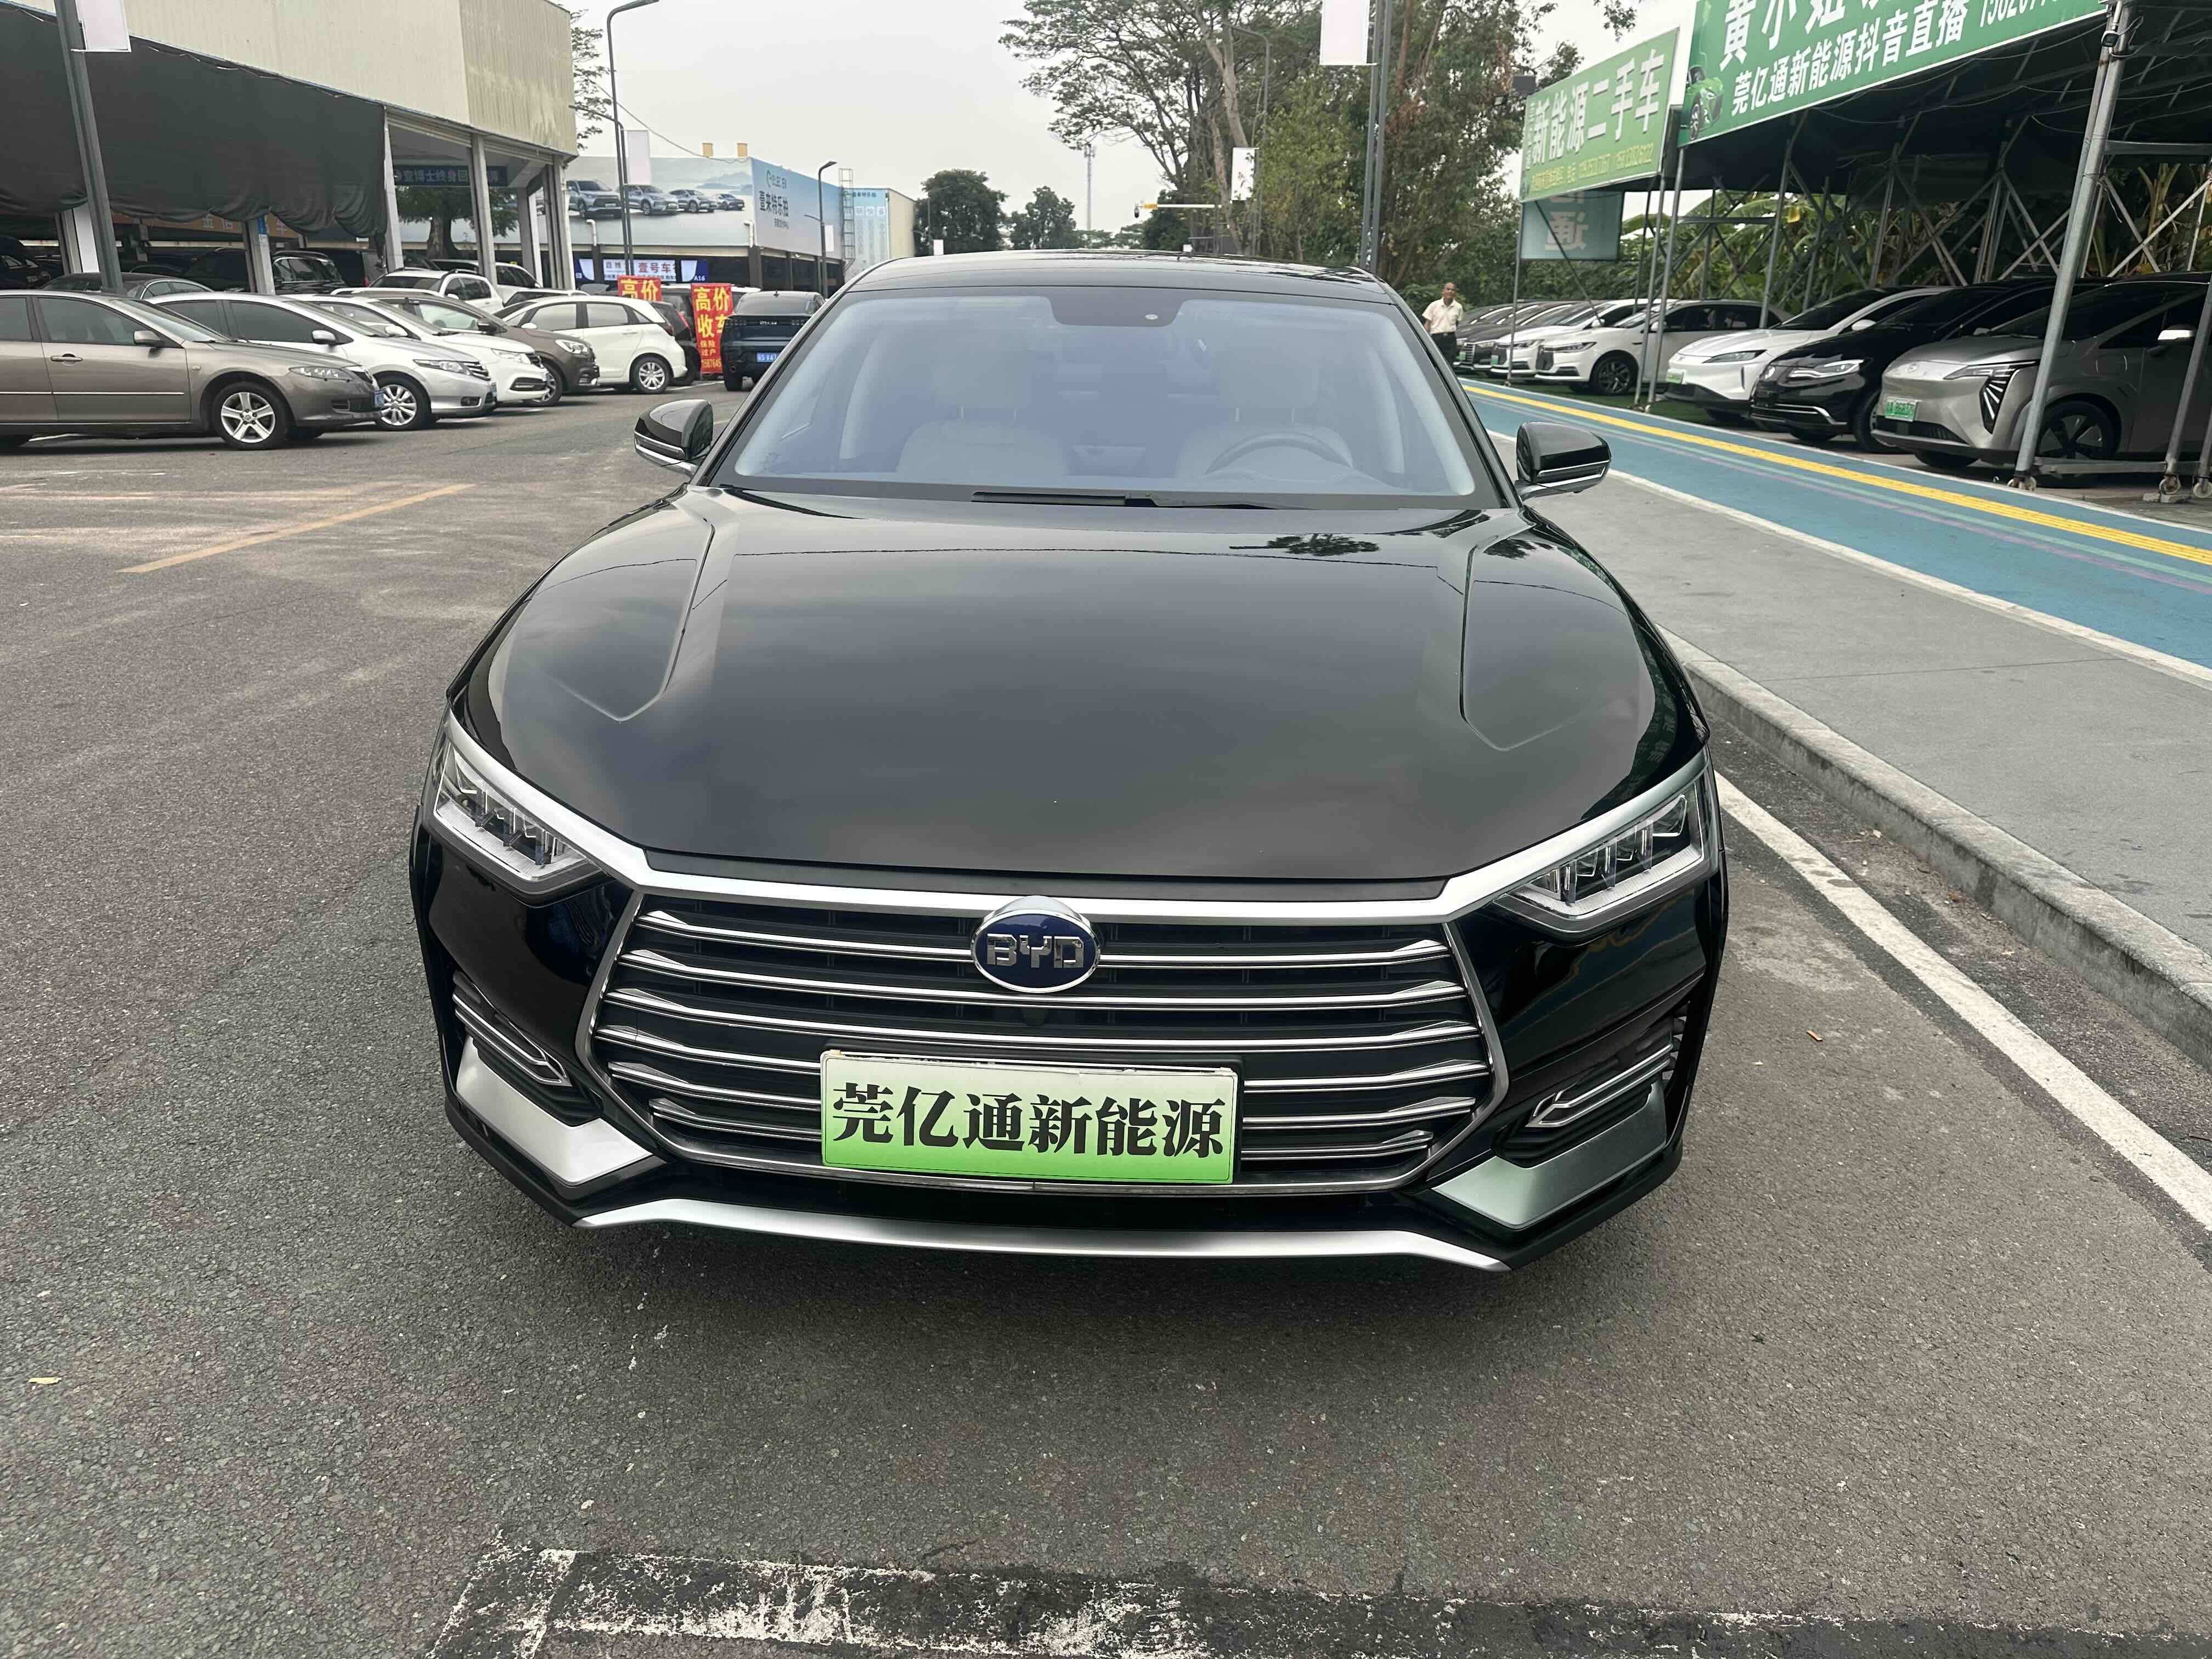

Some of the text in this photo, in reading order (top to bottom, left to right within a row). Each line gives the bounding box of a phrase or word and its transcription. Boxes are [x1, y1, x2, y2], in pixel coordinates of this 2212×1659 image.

[1731, 0, 1968, 116] 莞亿通新能源抖音直播
[1531, 49, 1664, 165] 新能源二手车
[638, 262, 675, 273] 壹号车
[620, 279, 659, 301] 高价
[693, 287, 729, 311] 高价
[697, 314, 726, 338] 收车
[987, 933, 1084, 969] BYD
[833, 1082, 1226, 1159] 莞亿通新能源
